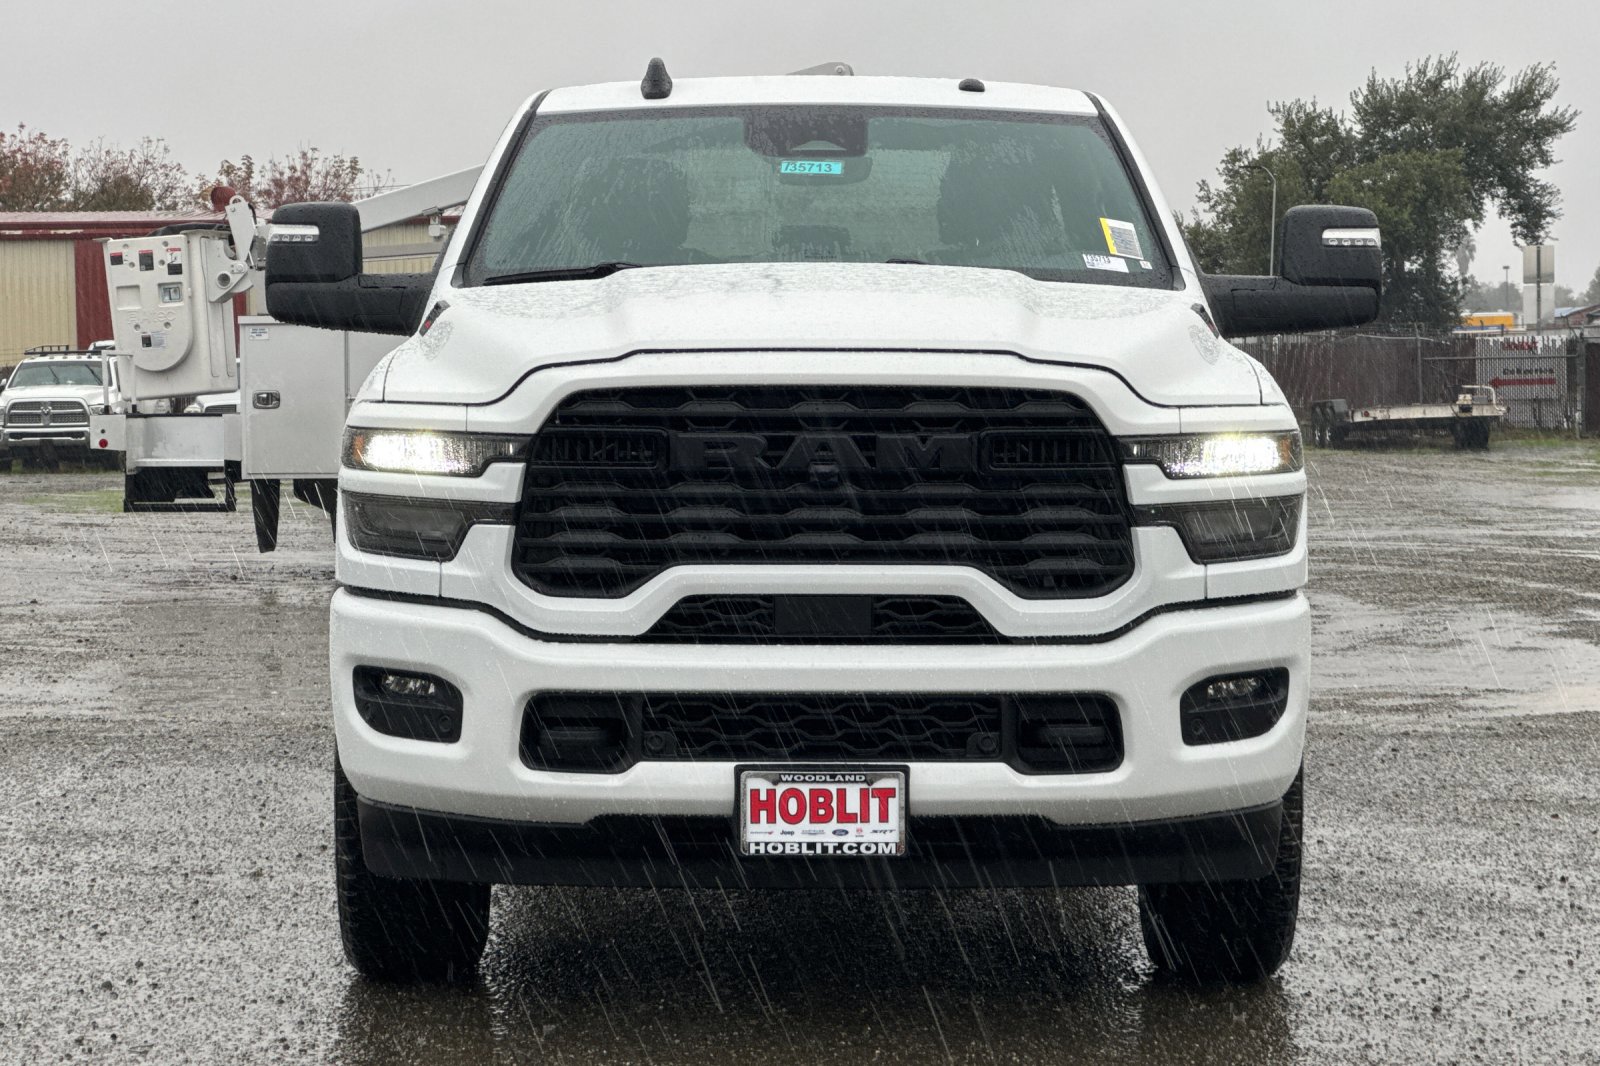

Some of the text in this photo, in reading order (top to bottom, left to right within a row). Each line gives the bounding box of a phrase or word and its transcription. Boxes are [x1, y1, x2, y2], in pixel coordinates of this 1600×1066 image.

[784, 162, 832, 172] 735713
[673, 432, 972, 473] RAM
[780, 774, 866, 782] WOODLAND
[750, 787, 896, 825] HOBLIT
[750, 842, 896, 854] HOBLIT.COM
